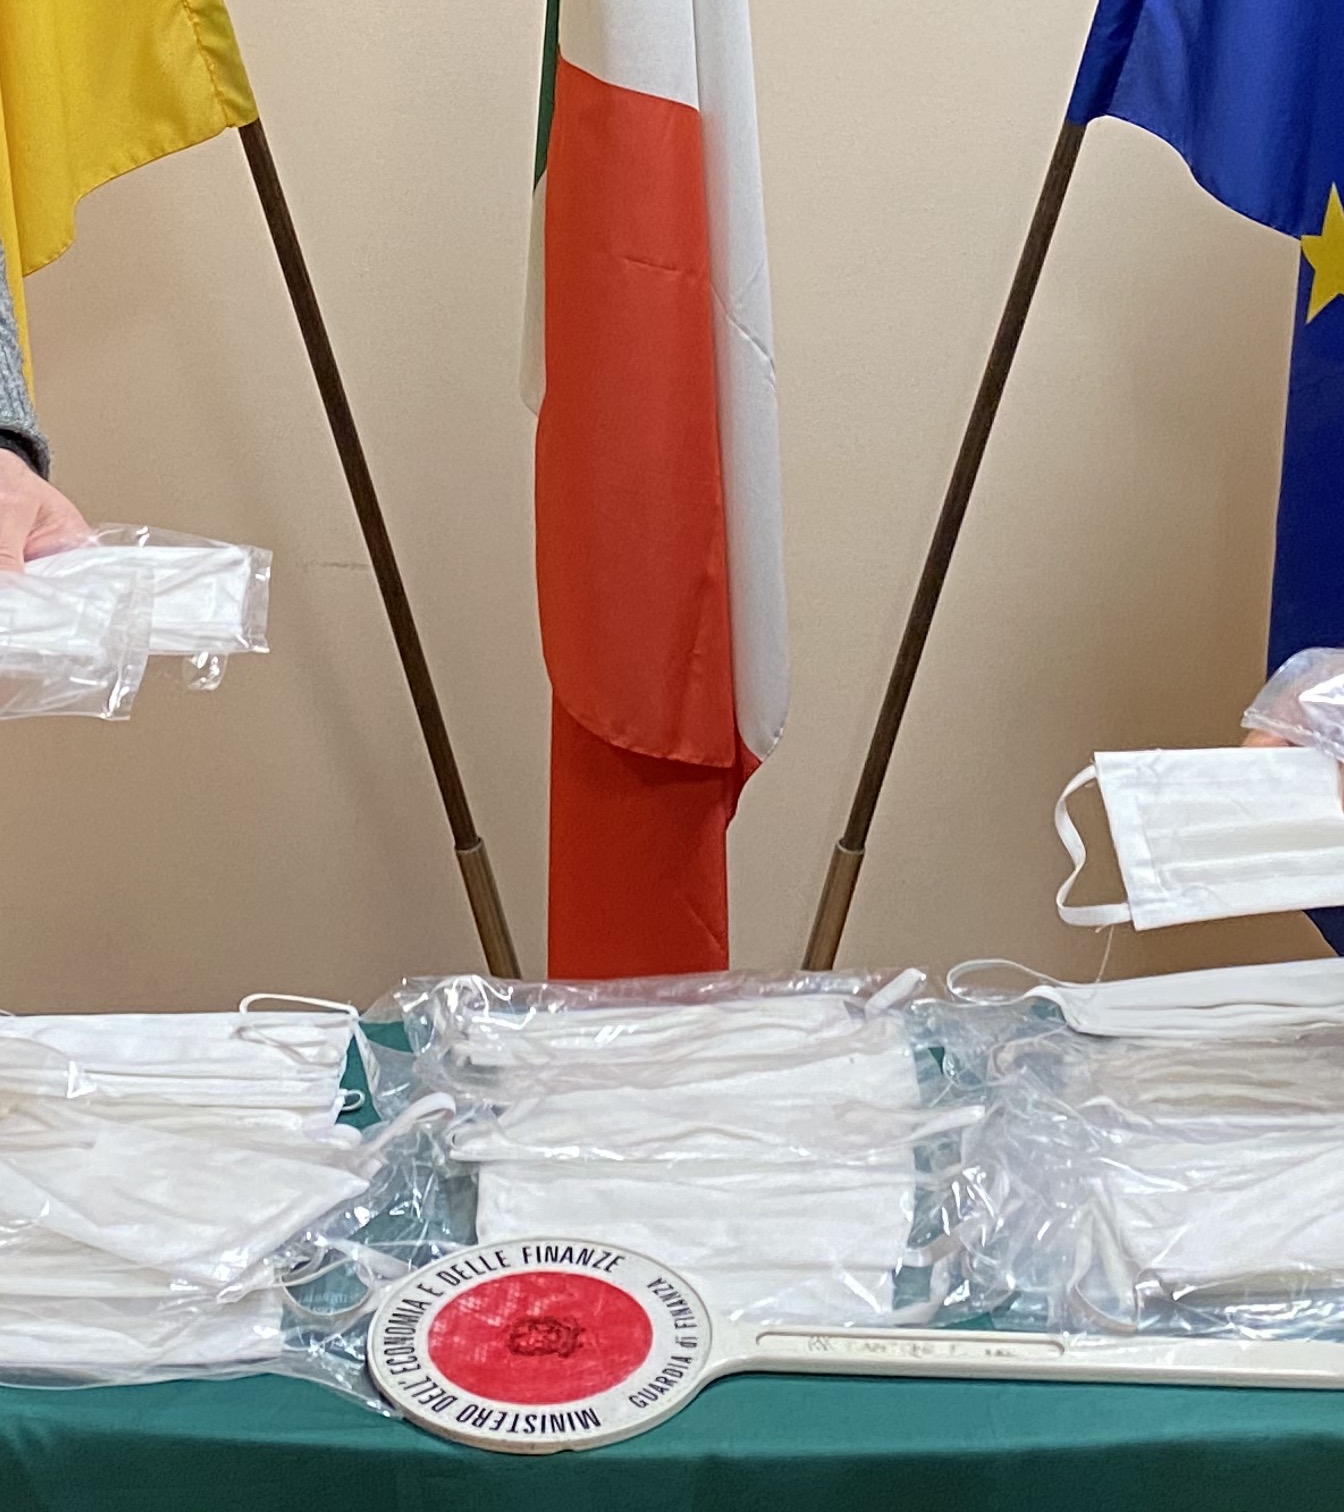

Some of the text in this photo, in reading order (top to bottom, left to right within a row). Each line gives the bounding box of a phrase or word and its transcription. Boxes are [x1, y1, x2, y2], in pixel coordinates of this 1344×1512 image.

[435, 1249, 512, 1287] DELLE
[521, 1244, 626, 1274] FINANZE
[416, 1282, 445, 1297] E
[646, 1276, 699, 1331] FINANZA
[628, 1354, 694, 1410] GUARDIA
[455, 1402, 603, 1434] MINISTERO
